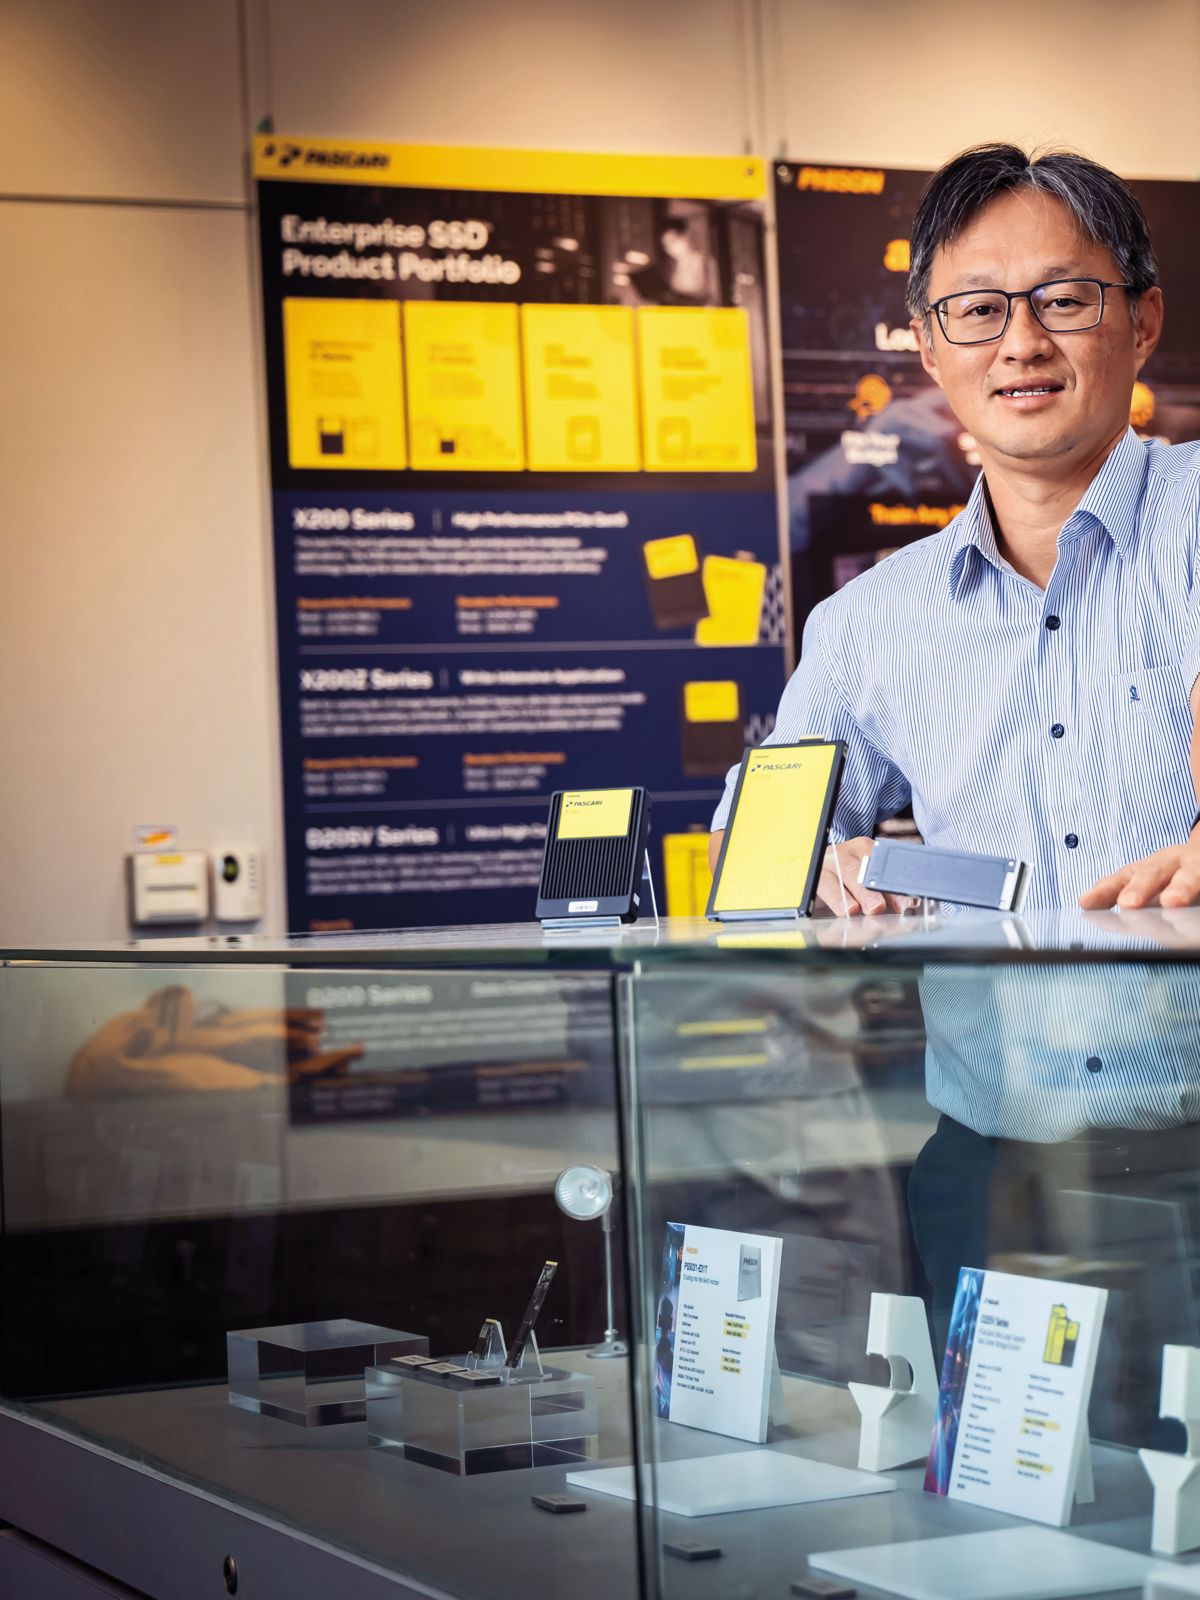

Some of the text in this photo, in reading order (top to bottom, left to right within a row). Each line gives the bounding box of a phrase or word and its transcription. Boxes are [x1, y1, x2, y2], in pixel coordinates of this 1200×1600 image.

[281, 214, 488, 252] Enterprise SSD
[282, 248, 520, 284] Product Portfolio
[293, 508, 414, 530] X200 Series
[300, 668, 432, 690] X200Z Series
[376, 825, 438, 847] Series
[367, 983, 433, 1006] Series
